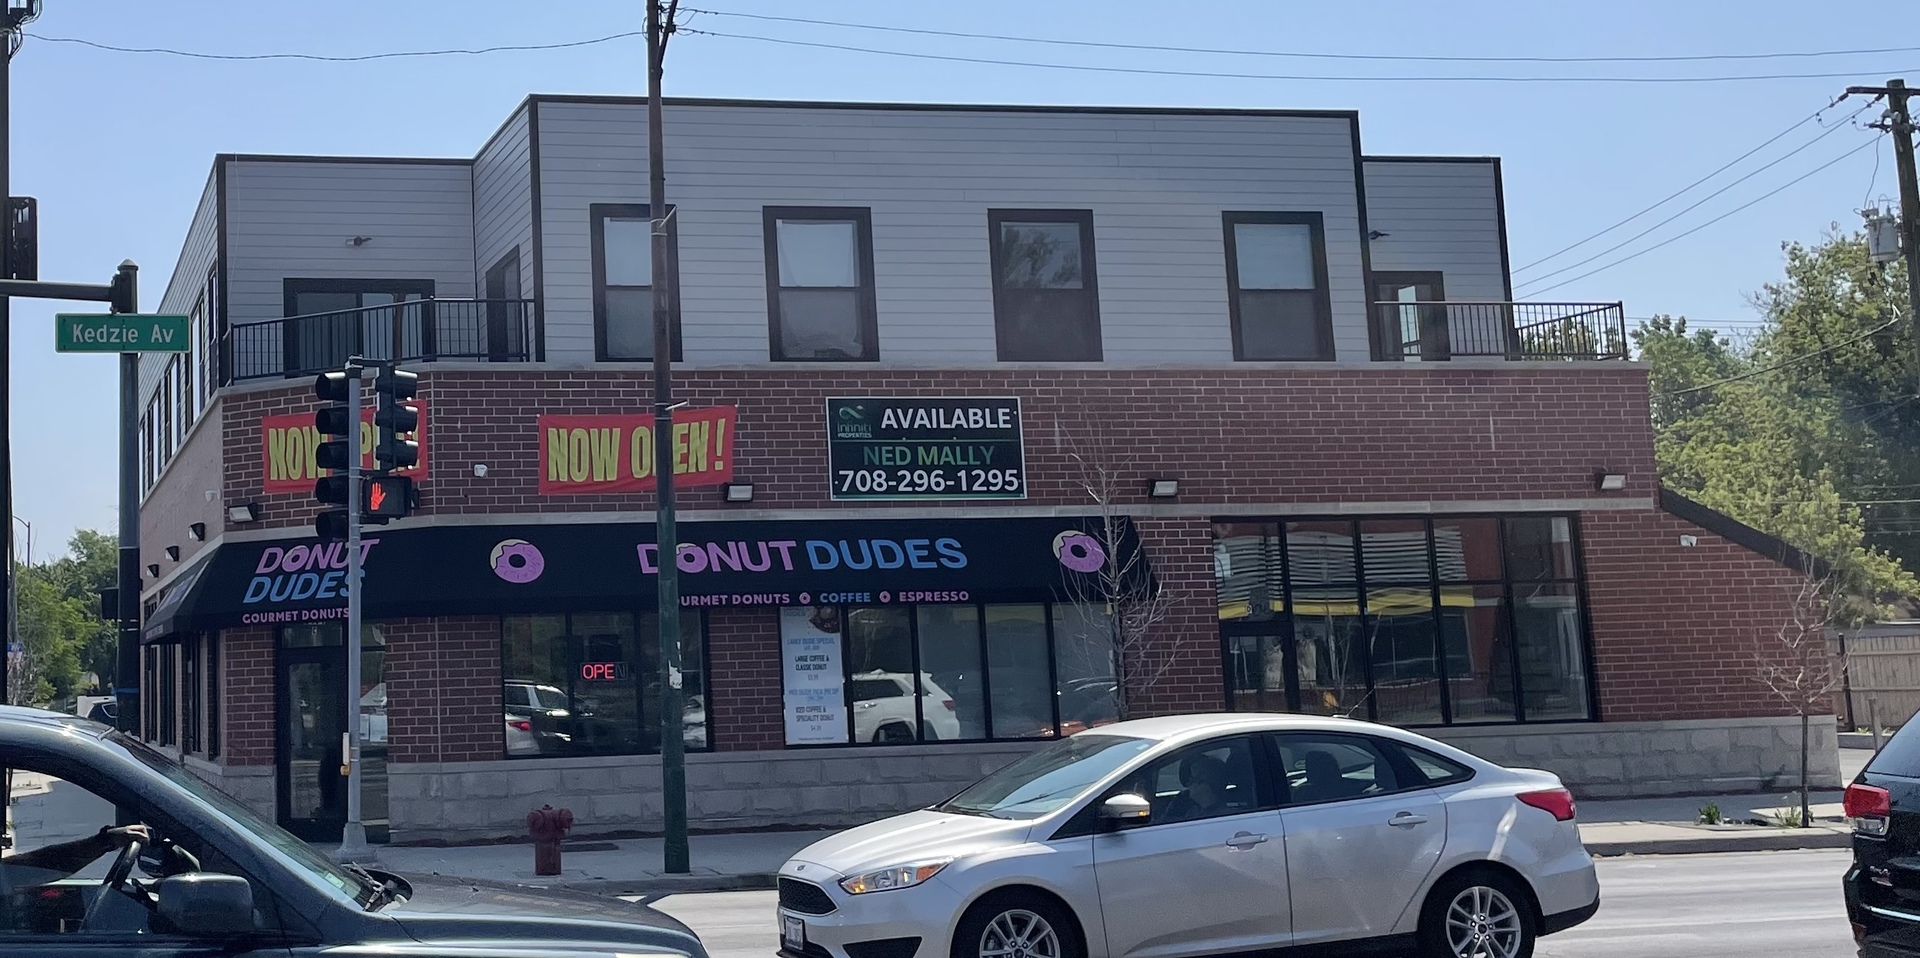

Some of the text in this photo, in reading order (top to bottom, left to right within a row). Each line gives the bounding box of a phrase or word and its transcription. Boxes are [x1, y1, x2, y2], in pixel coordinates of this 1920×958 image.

[72, 324, 174, 343] Kedzie Av
[881, 408, 1012, 429] AVAILABLE
[547, 418, 726, 482] NOW OEN!
[863, 445, 995, 466] NED MALLY
[838, 469, 1019, 492] 708-296-1295
[255, 538, 380, 574] DONUT
[636, 538, 968, 574] DONUT DUDES
[676, 591, 970, 606] URMET DONUTS COFFEE ESPRESSO
[242, 607, 350, 624] GOURMET DONUTS
[582, 664, 626, 679] OPEN
